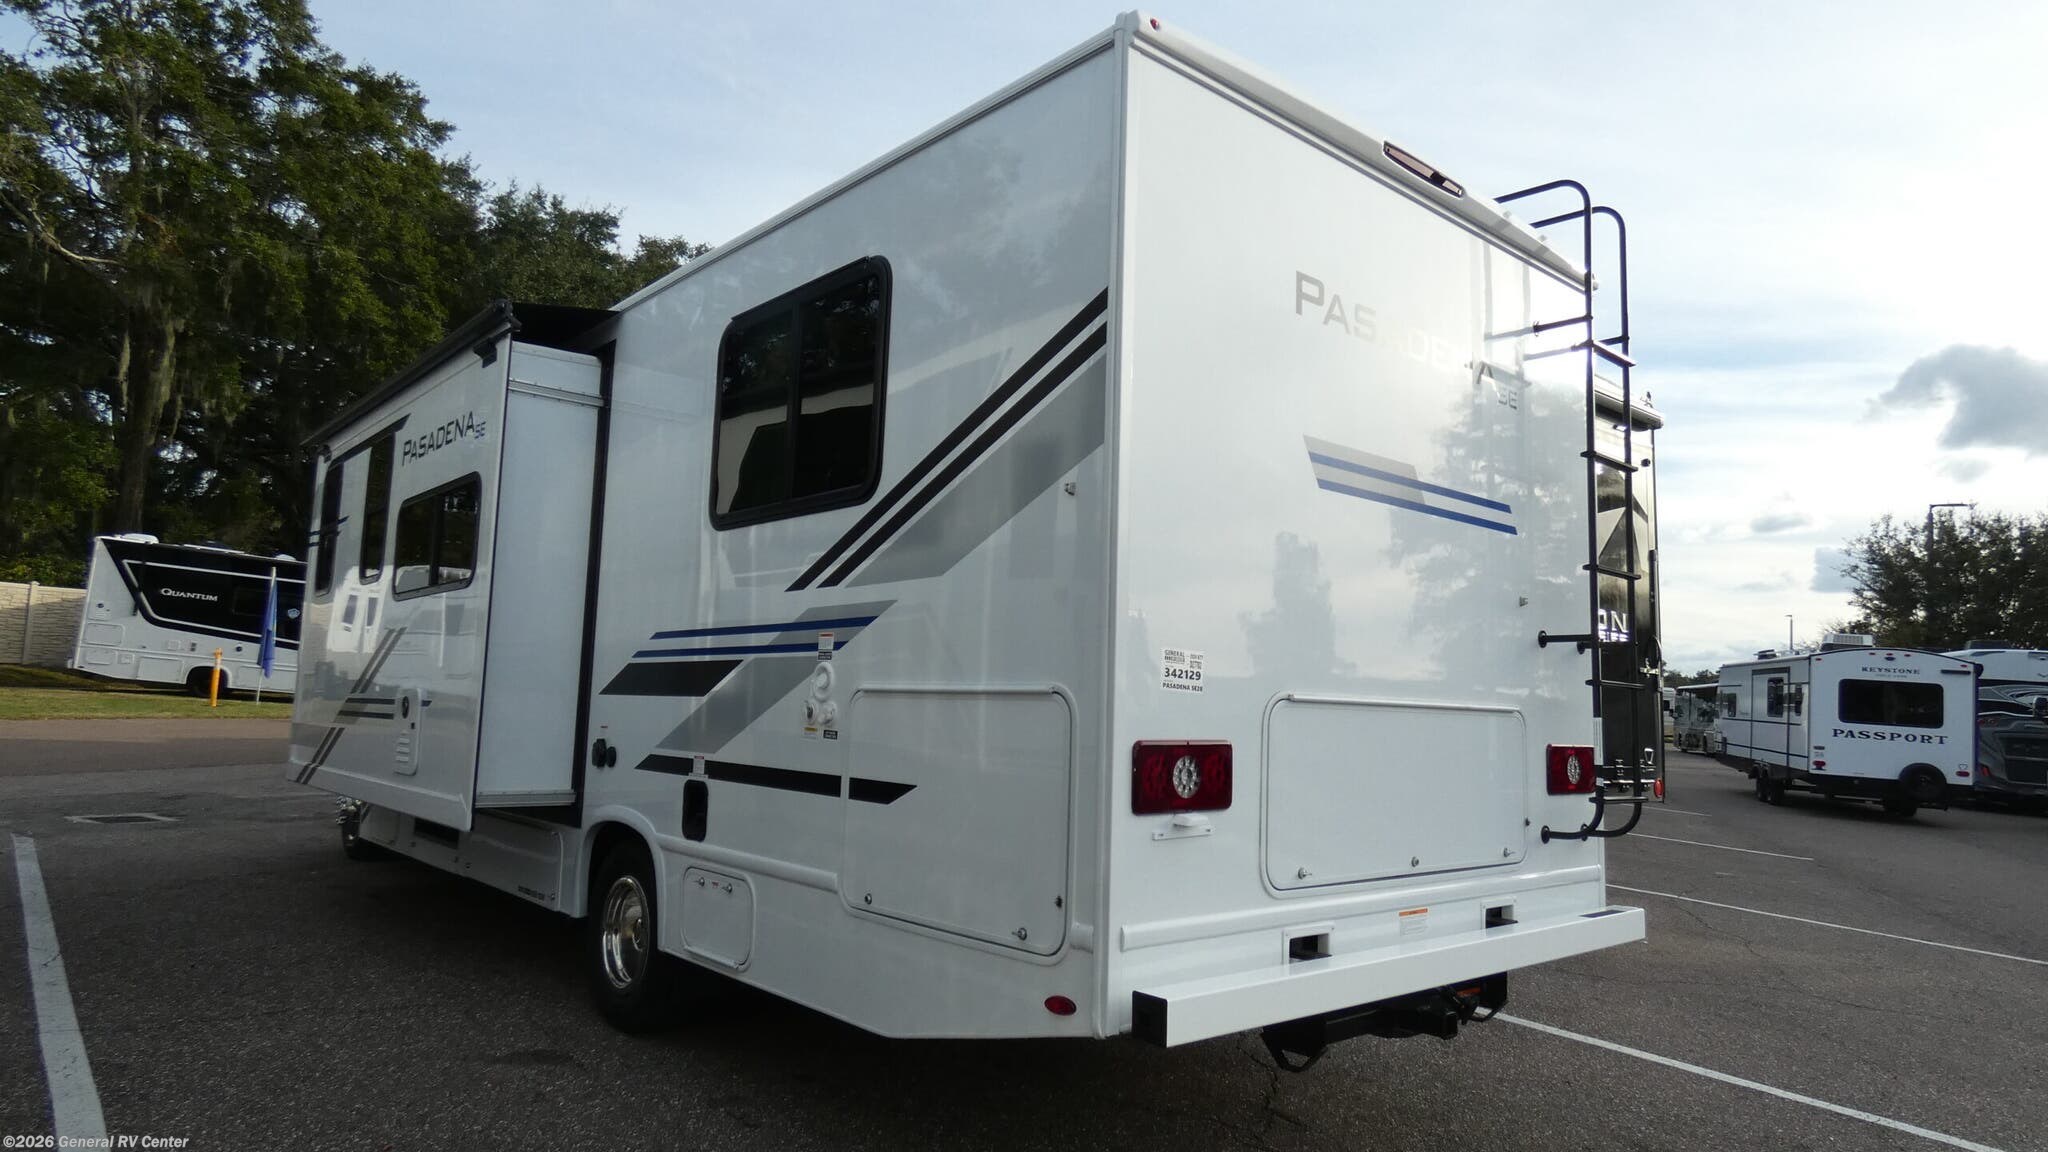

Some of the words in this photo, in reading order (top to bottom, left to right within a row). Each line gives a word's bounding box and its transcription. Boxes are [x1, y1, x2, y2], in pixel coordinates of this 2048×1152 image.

[1295, 270, 1497, 389] PASDEA
[402, 411, 475, 467] PASADENA
[474, 421, 487, 439] SE
[161, 587, 218, 601] QUANTUM
[1164, 667, 1202, 681] 342129
[1862, 666, 1920, 675] KEYSTONE
[1163, 682, 1190, 690] PASADENA
[1832, 728, 1948, 745] PASSPORT
